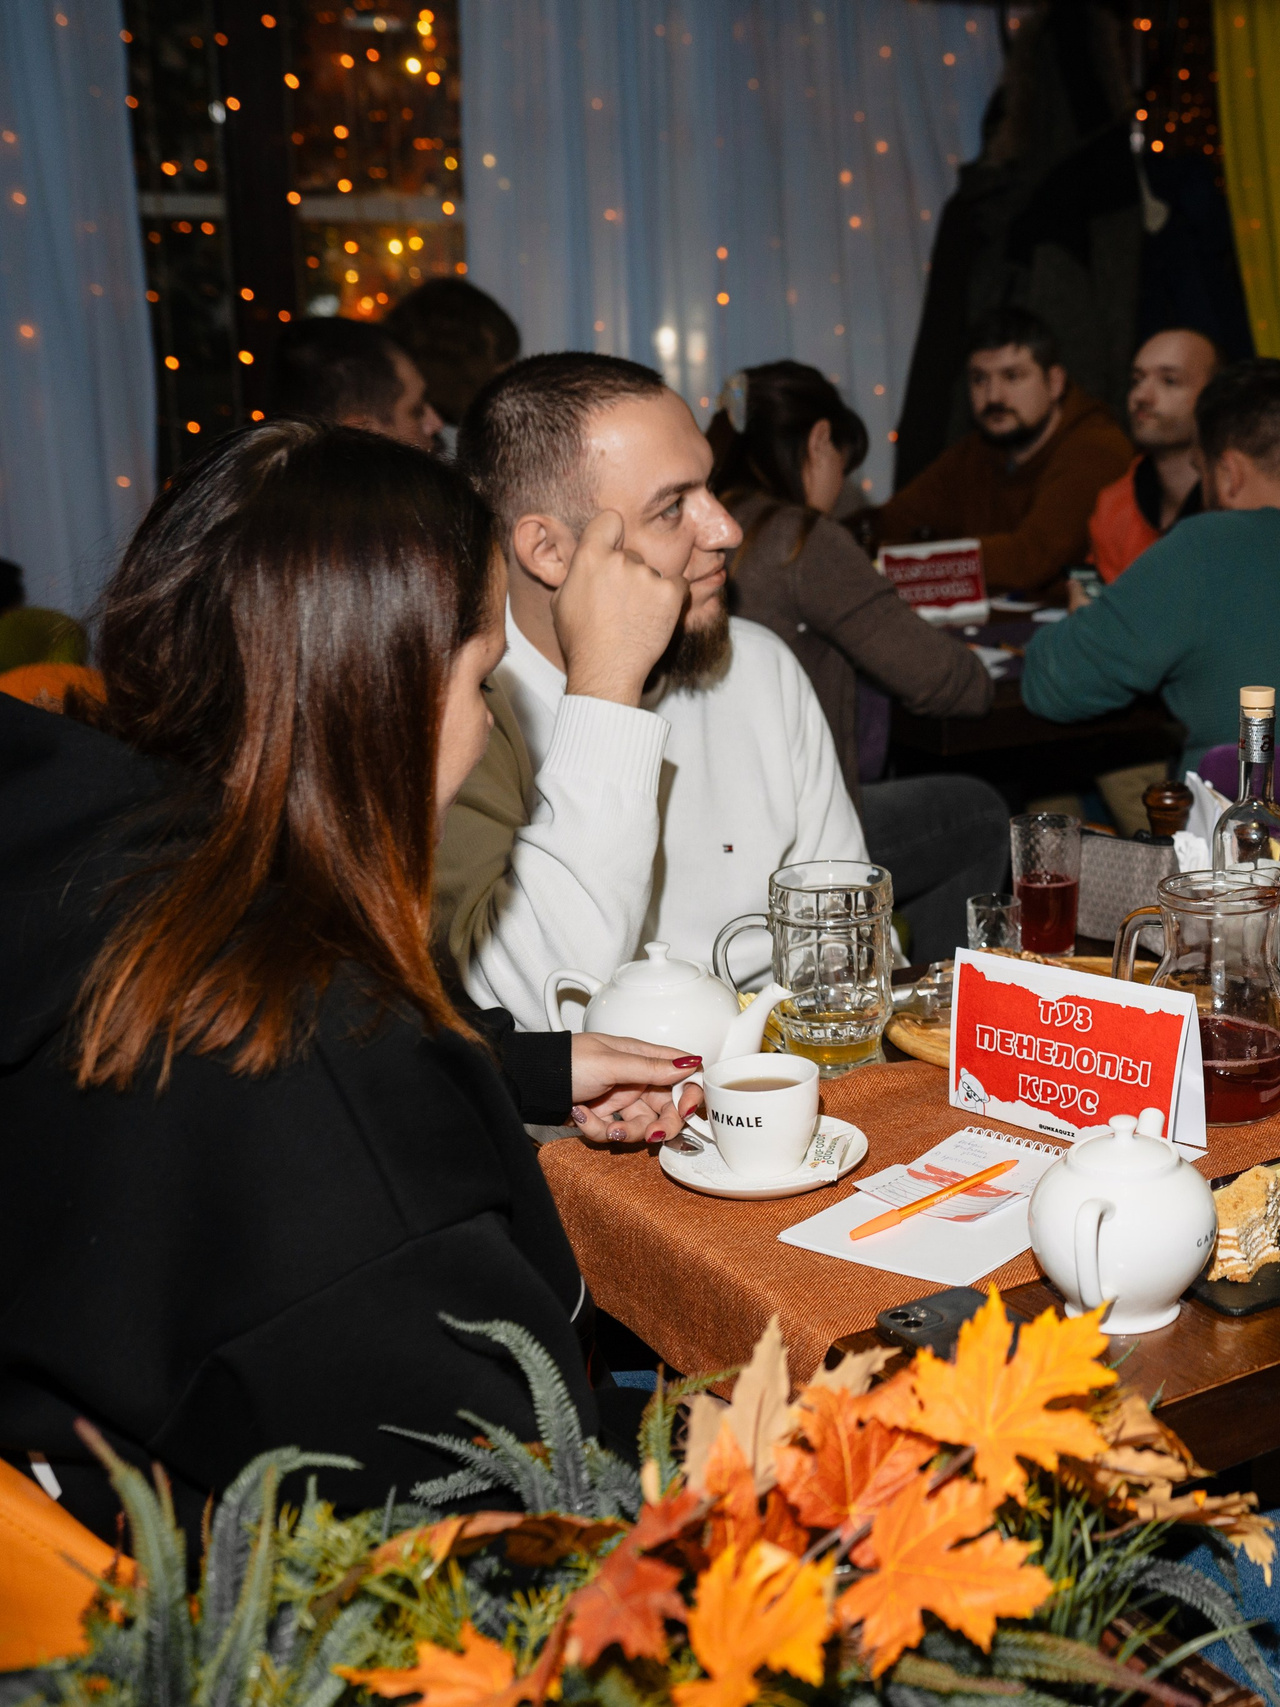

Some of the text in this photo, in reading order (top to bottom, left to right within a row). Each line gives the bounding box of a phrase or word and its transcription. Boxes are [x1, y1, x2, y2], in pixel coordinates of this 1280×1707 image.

[1038, 998, 1093, 1033] ТУЗ
[976, 1024, 1152, 1088] ПЕНЕЛОПЫ
[1018, 1073, 1099, 1116] КРУС
[711, 1109, 763, 1128] MIKALE
